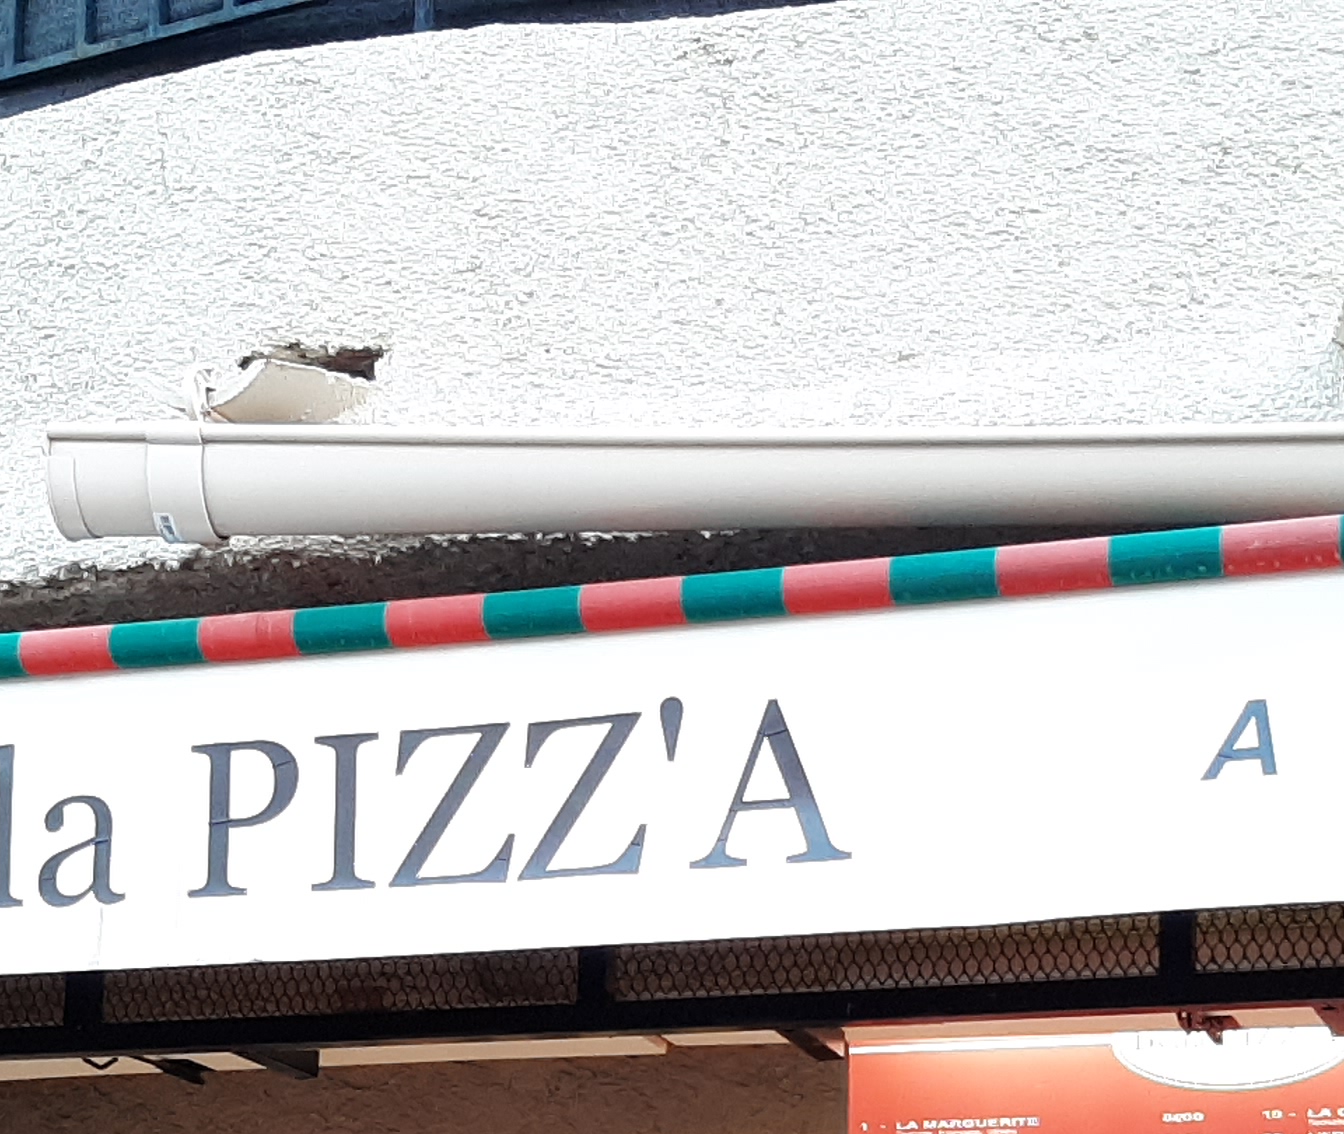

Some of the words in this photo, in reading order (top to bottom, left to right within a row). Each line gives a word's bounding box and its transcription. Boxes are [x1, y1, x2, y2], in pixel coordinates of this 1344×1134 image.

[1201, 698, 1277, 780] A
[188, 697, 851, 897] PIZZ'A
[896, 1121, 918, 1130] LA
[1307, 1108, 1331, 1118] LA
